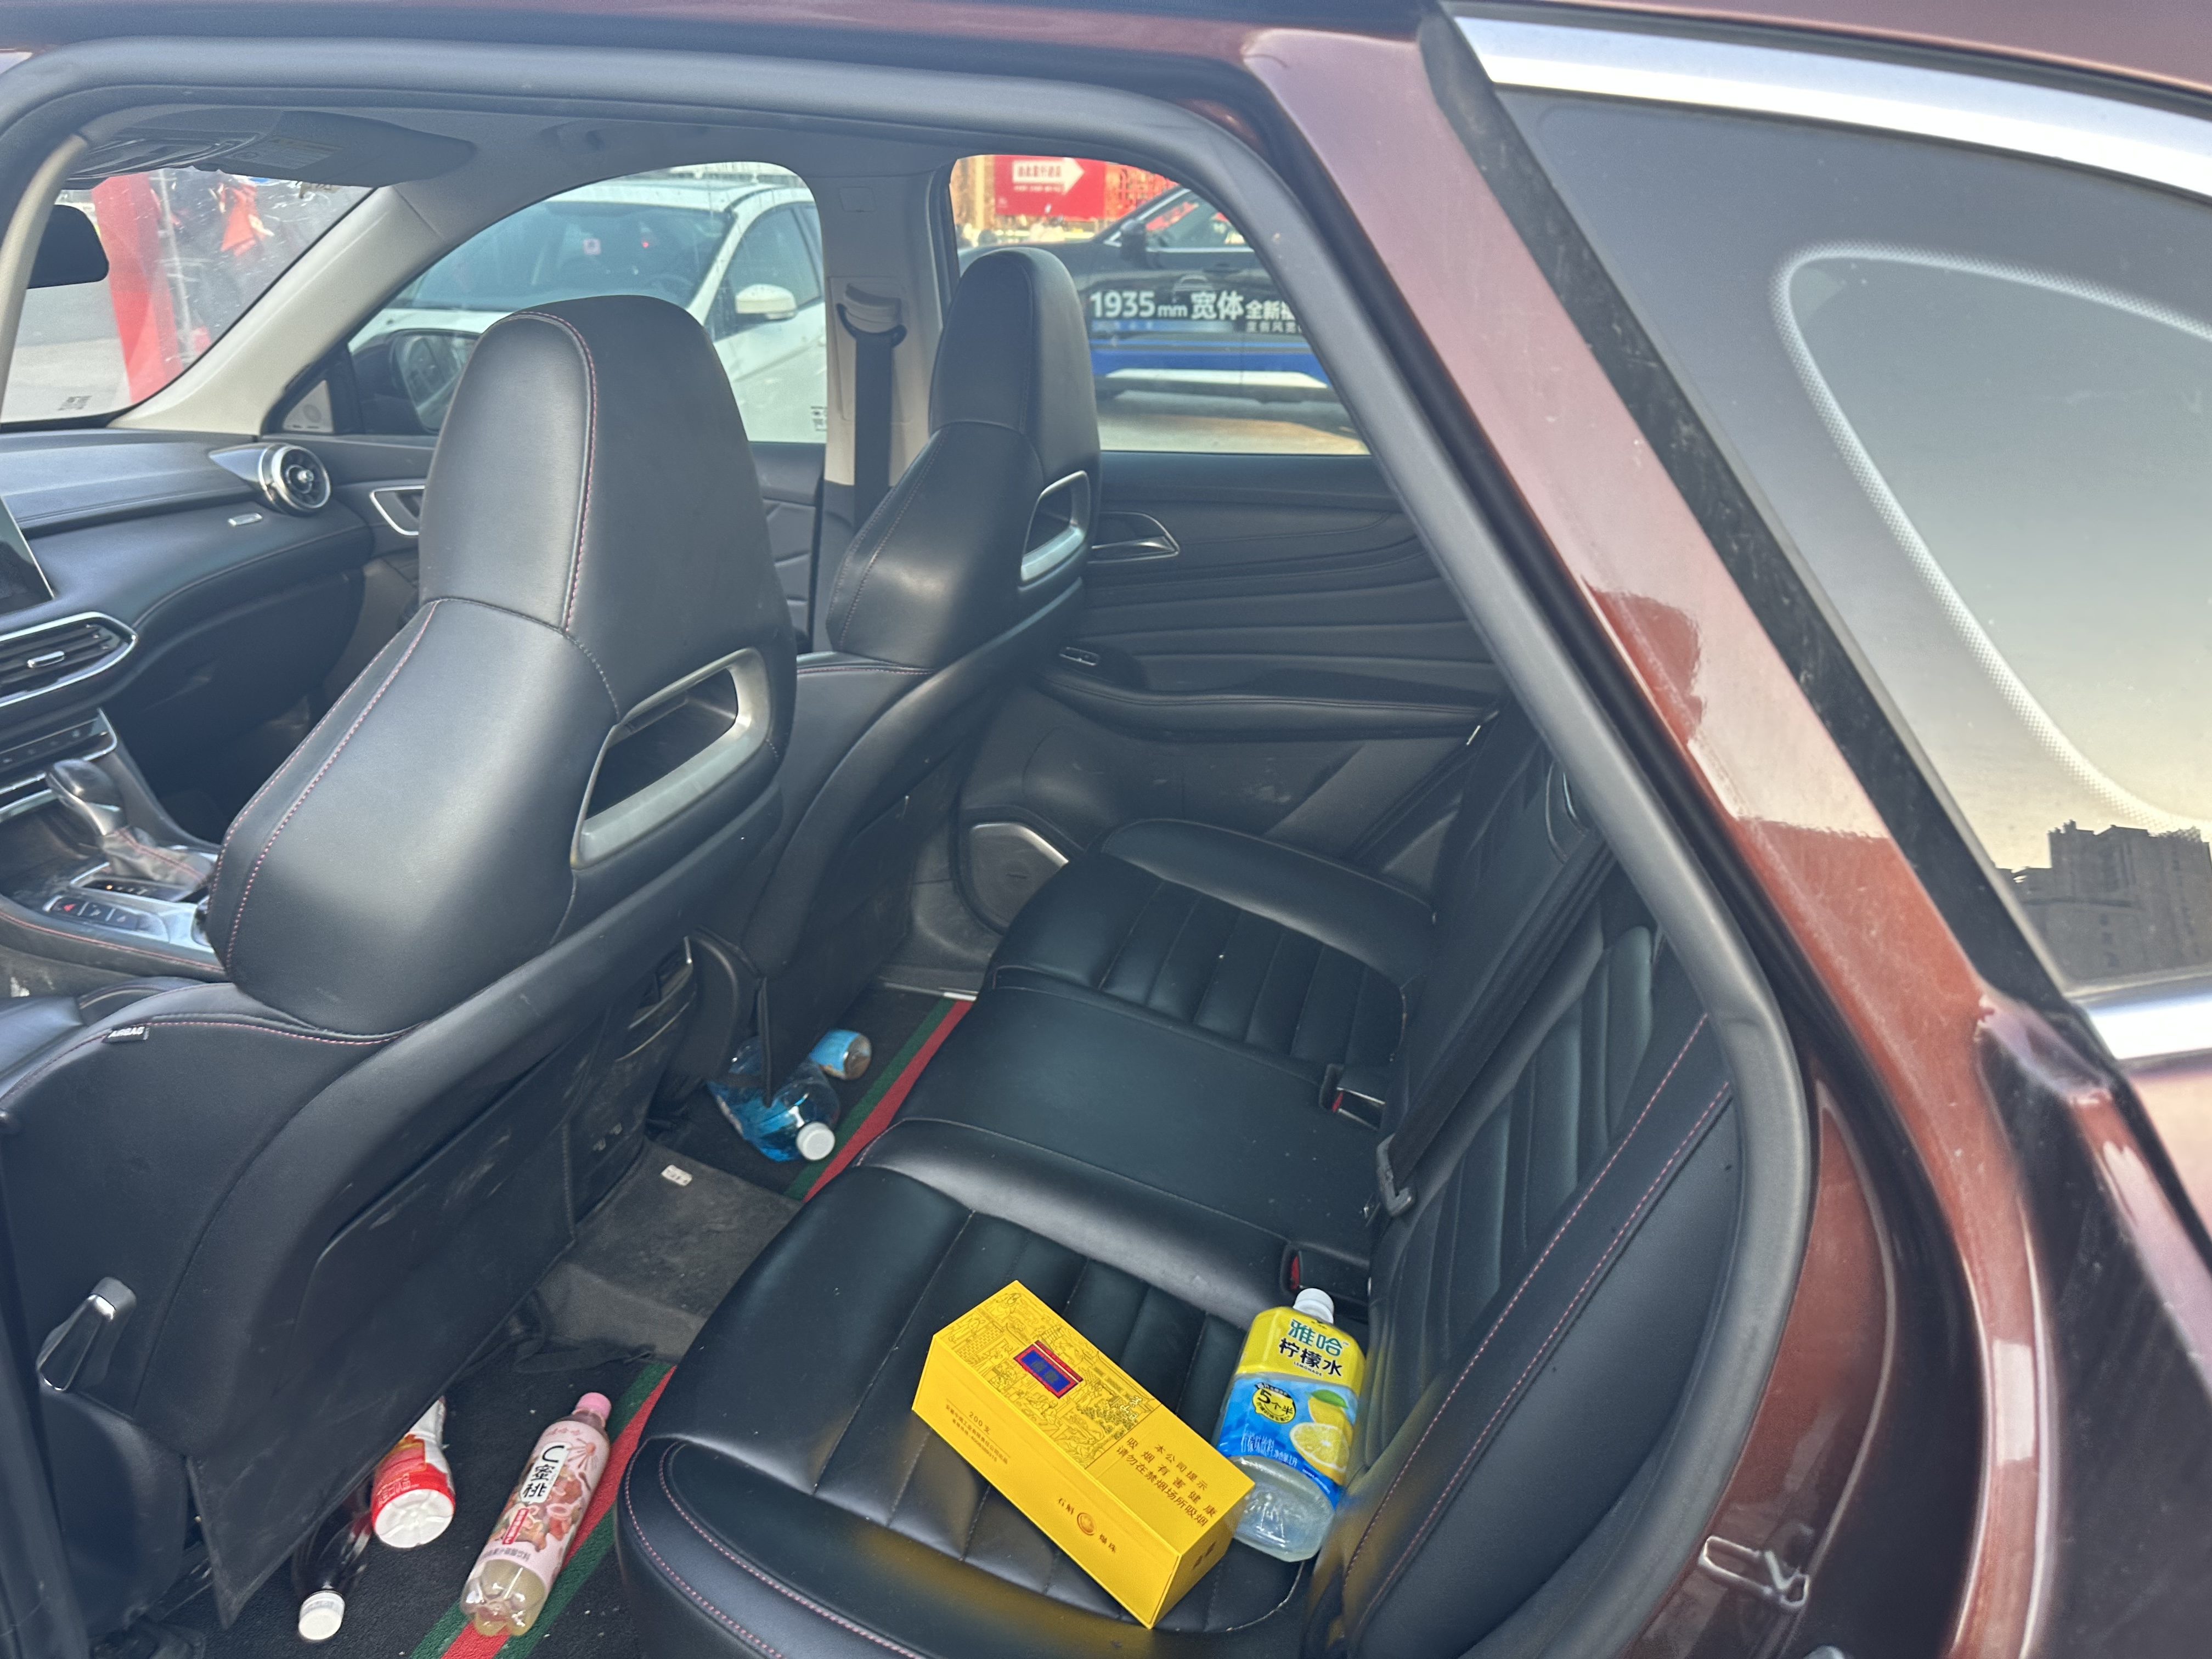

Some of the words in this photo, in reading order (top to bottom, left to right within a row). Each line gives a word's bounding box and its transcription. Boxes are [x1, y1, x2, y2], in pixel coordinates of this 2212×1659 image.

[1279, 1338, 1342, 1376] 柠檬水
[1288, 1318, 1342, 1357] 雅哈
[1294, 1361, 1322, 1376] LEMONADE
[1257, 1390, 1293, 1415] 5个半
[1116, 1446, 1208, 1527] 请勿在禁烟场所吸烟
[1126, 1437, 1217, 1517] 吸烟有害健康
[1154, 1444, 1207, 1491] 本公司提示
